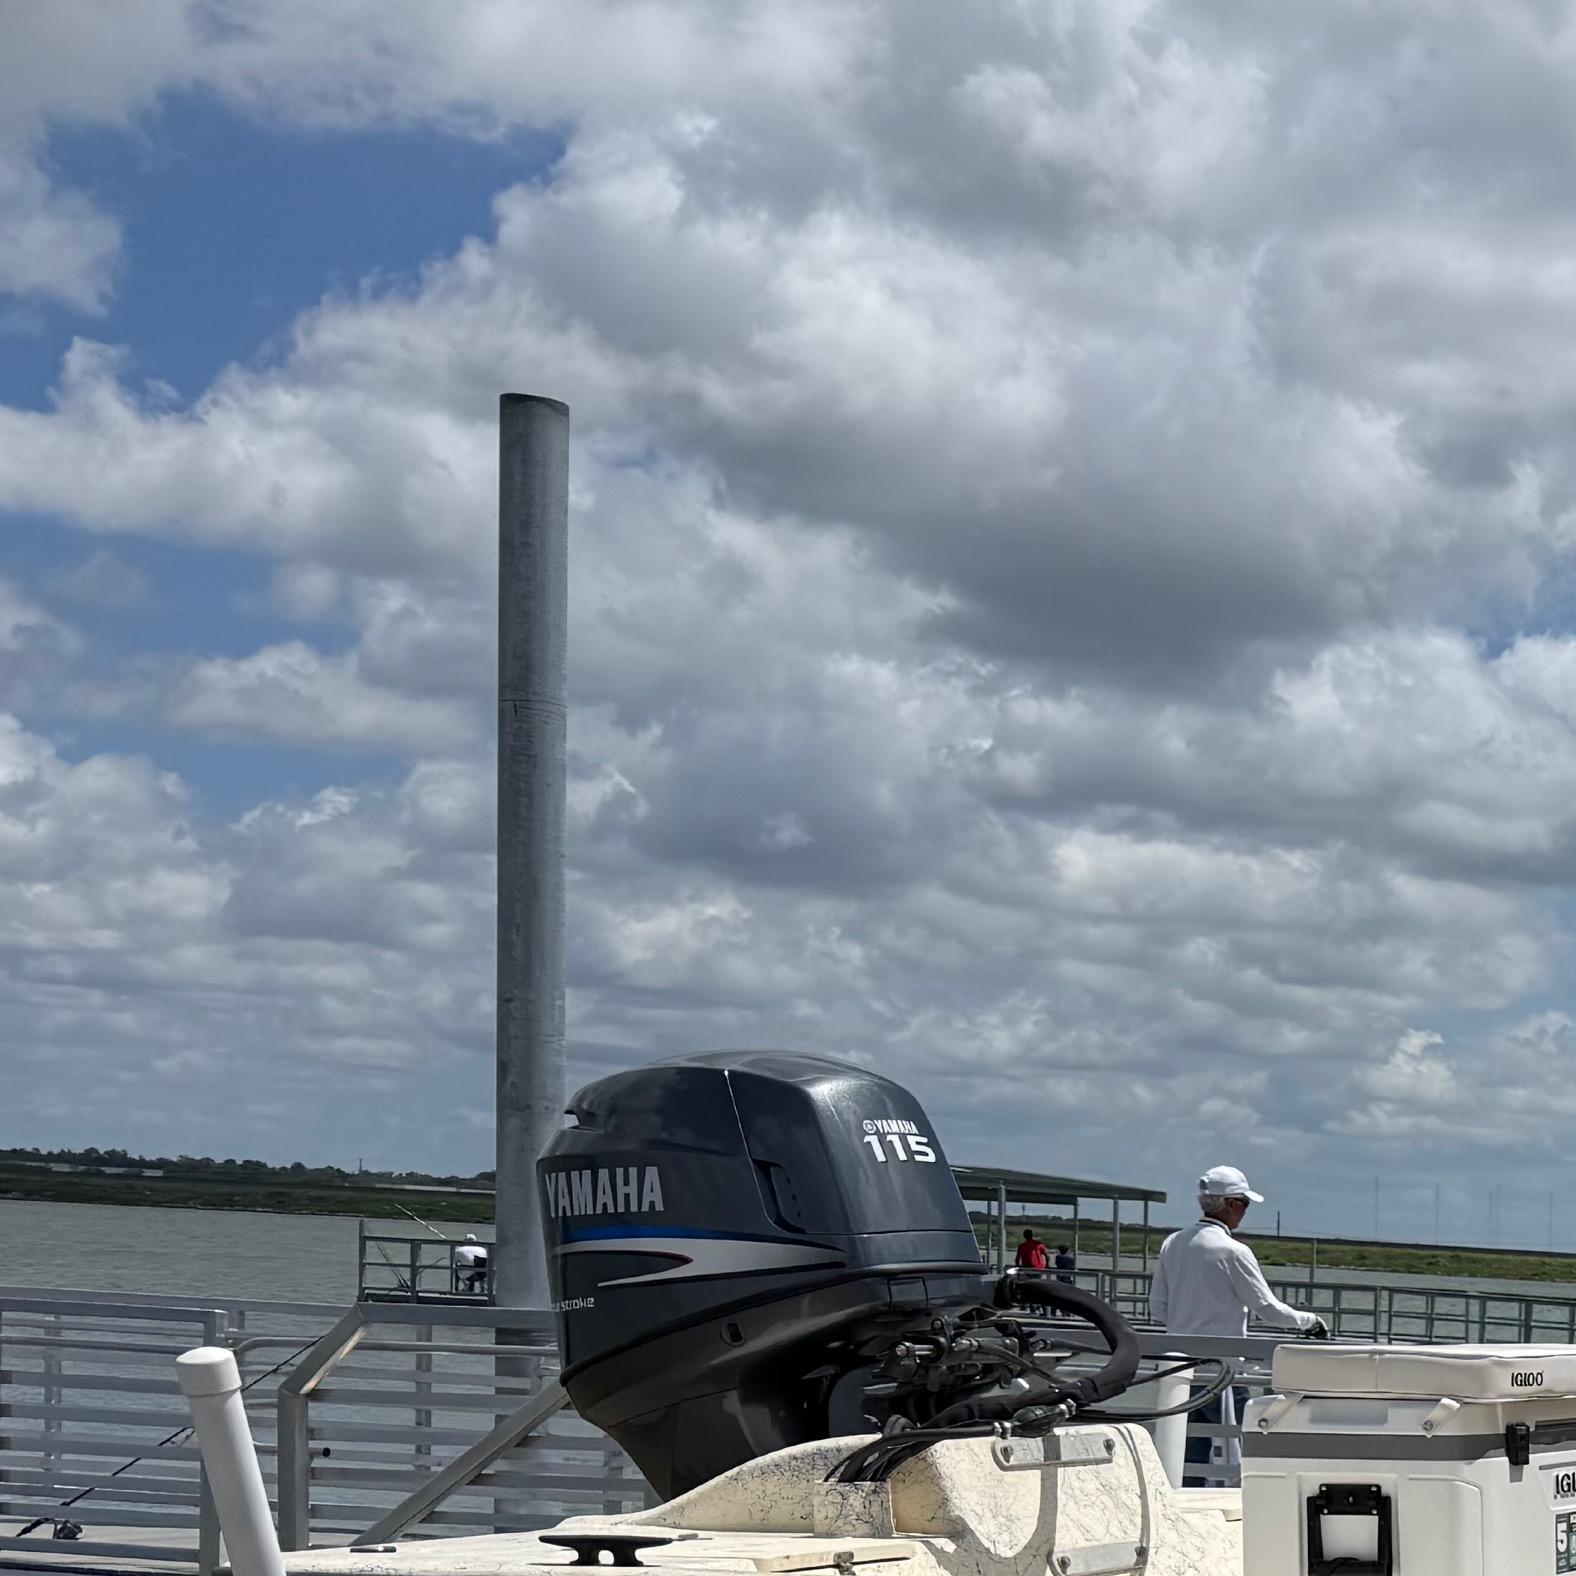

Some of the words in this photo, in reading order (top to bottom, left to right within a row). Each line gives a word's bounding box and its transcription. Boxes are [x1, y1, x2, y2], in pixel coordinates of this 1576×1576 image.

[874, 1119, 919, 1134] YAMAHA
[863, 1134, 937, 1163] 115
[546, 1166, 664, 1218] YAMAHA
[1511, 1372, 1544, 1387] IGLOO
[1557, 1522, 1568, 1553] 5
